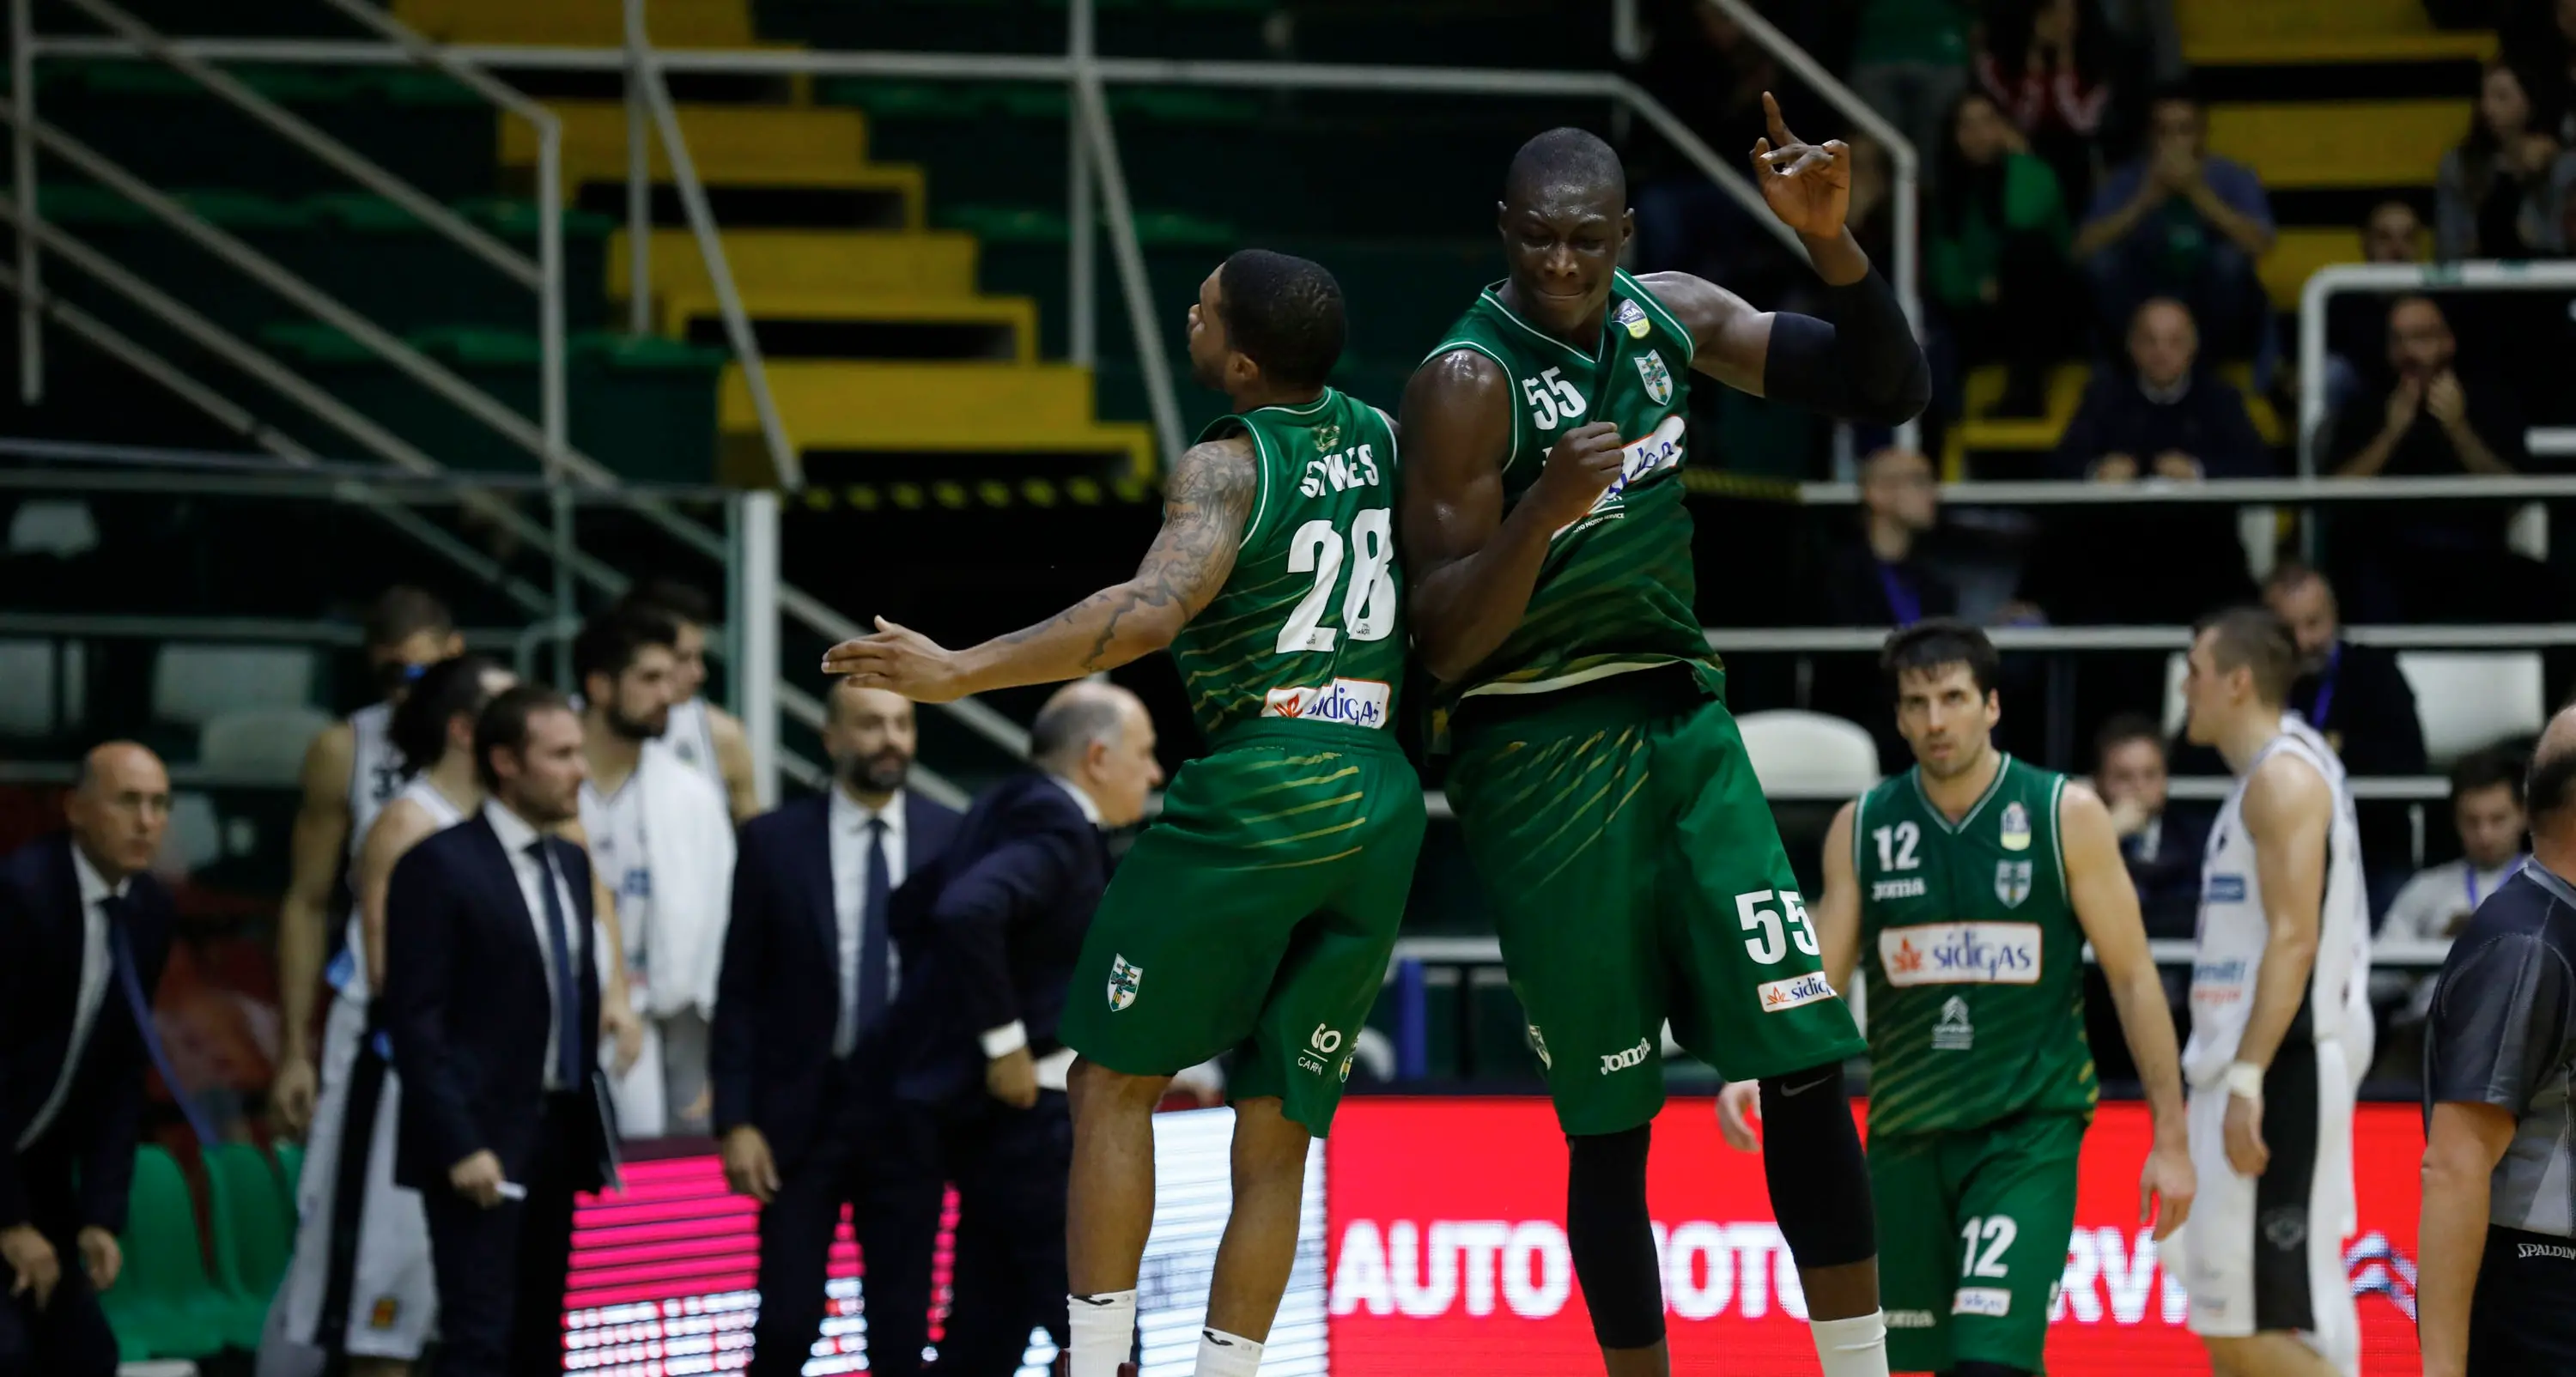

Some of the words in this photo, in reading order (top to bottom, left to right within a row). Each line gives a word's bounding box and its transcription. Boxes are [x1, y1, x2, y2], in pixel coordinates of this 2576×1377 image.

[1522, 366, 1587, 430] 55
[1276, 507, 1396, 654] 28
[1872, 820, 1921, 871] 12
[1735, 889, 1821, 965] 55
[1328, 1218, 1571, 1320] AUTO
[1960, 1214, 2018, 1277] 12
[2518, 1243, 2576, 1260] SPALDIN
